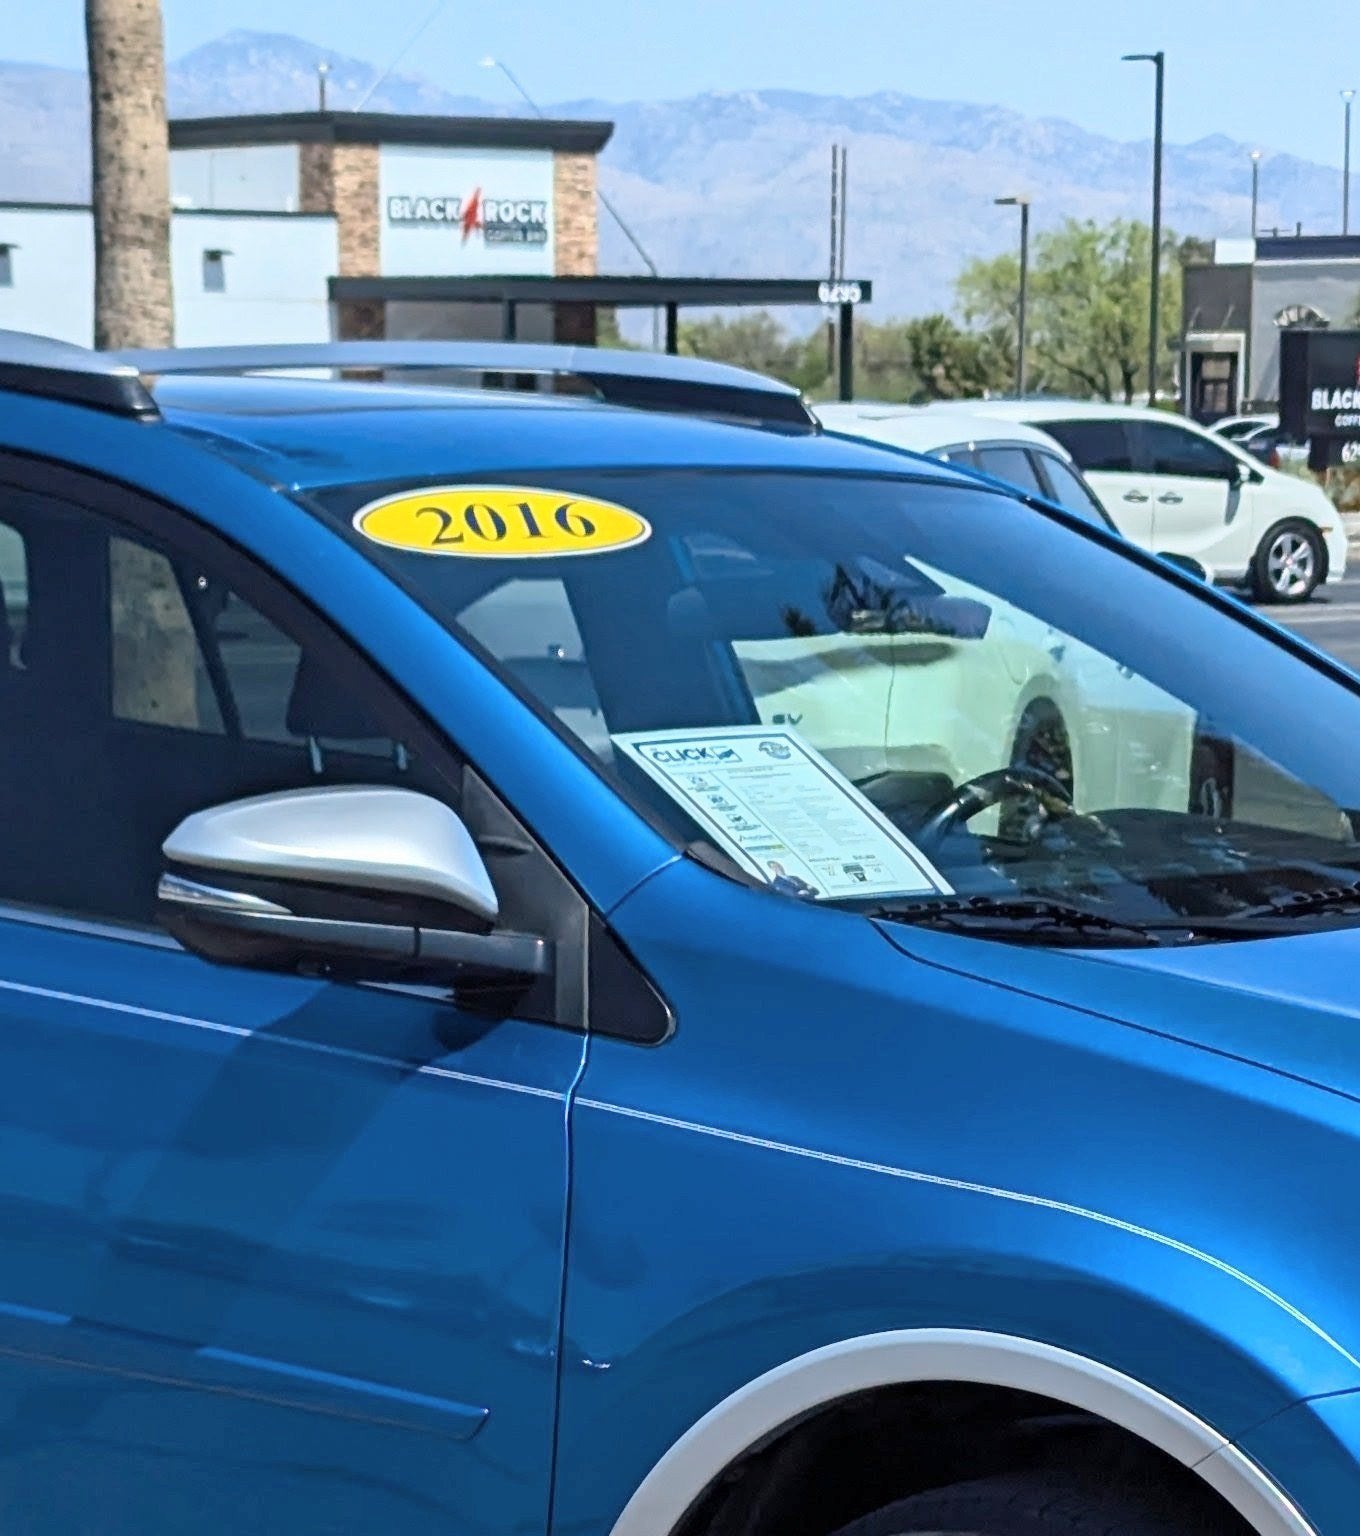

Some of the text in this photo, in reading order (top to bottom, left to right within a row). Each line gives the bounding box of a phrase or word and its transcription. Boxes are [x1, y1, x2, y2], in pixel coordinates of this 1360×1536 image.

[389, 197, 548, 224] BLACK ROCK
[415, 502, 596, 546] 2016
[652, 746, 715, 764] CLICK
